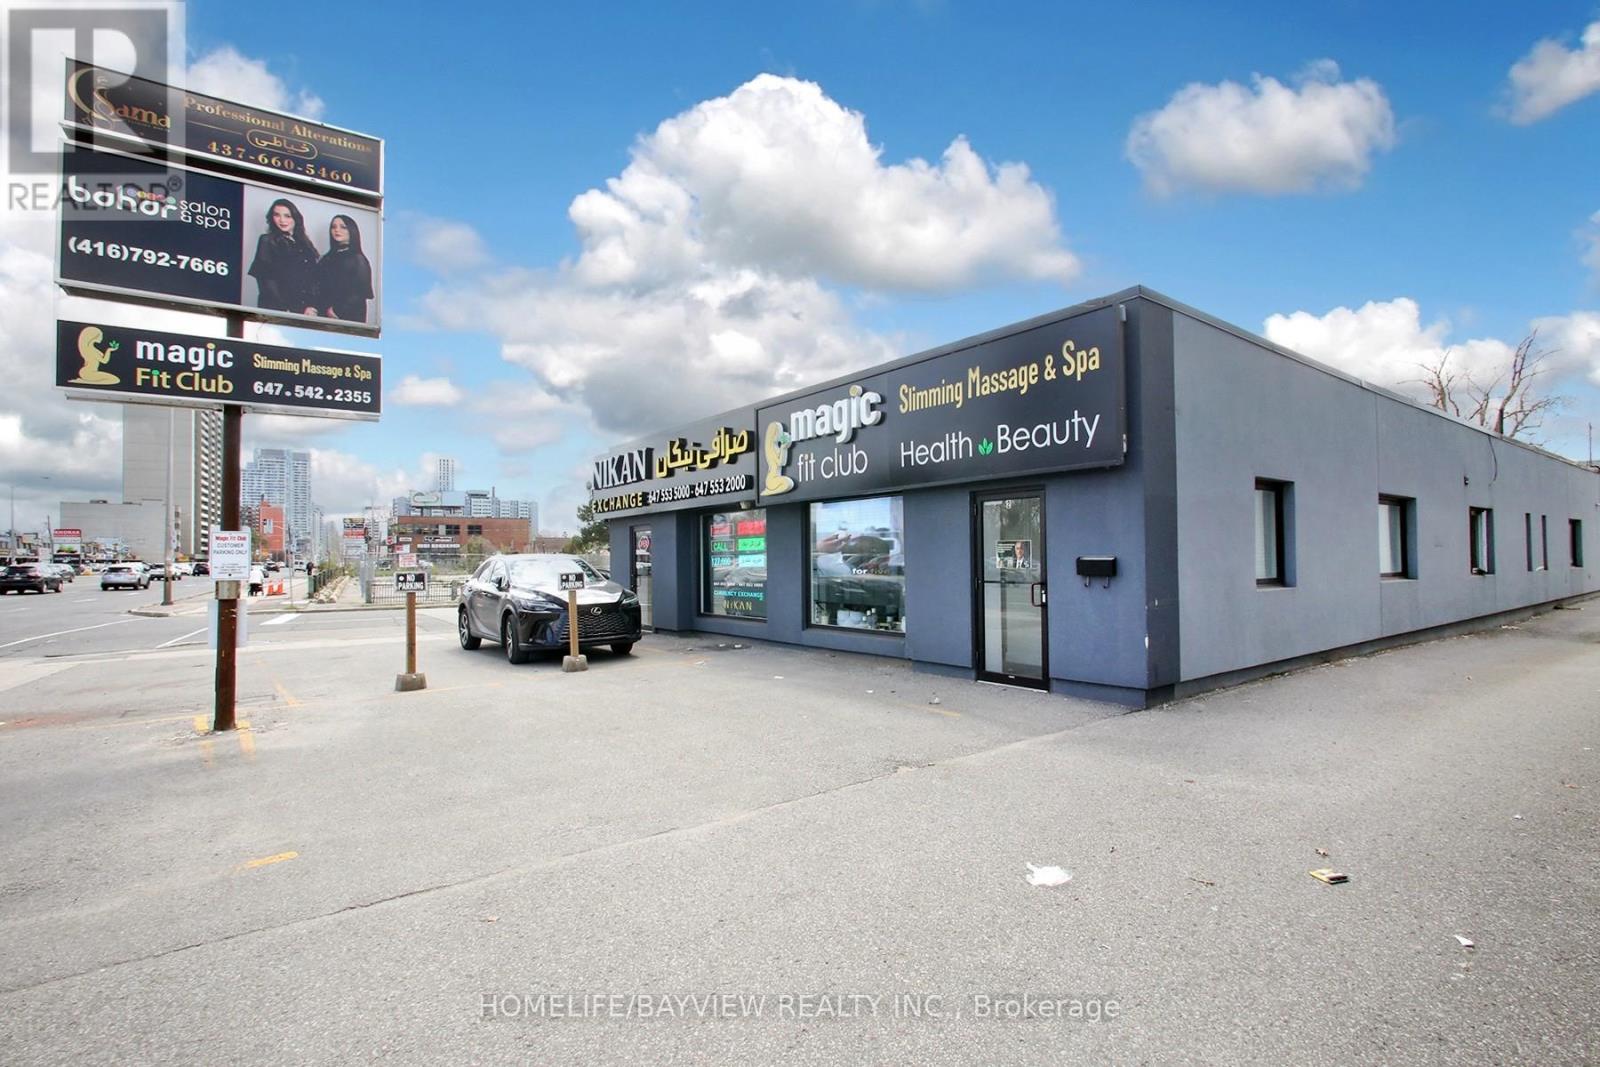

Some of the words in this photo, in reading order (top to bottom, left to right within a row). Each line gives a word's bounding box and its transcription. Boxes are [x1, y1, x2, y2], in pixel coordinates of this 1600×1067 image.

[184, 96, 285, 130] Professional
[291, 124, 372, 153] Alterations
[208, 141, 352, 184] 437-660-5460
[68, 175, 177, 219] bahar
[179, 200, 230, 218] salon
[181, 211, 192, 223] &
[195, 214, 230, 230] spa
[68, 236, 229, 277] (416)792-7666
[136, 339, 234, 371] magic
[253, 354, 300, 375] Slimming
[301, 360, 343, 379] Massage
[344, 365, 352, 377] &
[353, 364, 372, 381] Spa
[136, 367, 171, 390] Fit
[176, 372, 234, 394] Club
[900, 379, 963, 414] Slimming
[967, 361, 1038, 400] Massage
[1043, 354, 1057, 381] &
[1062, 339, 1100, 381] Spa
[253, 381, 371, 403] 647.542.2355
[790, 384, 883, 443] magic
[901, 431, 973, 467] Health
[997, 410, 1100, 454] Beauty
[591, 449, 647, 490] NIKAN
[797, 452, 815, 482] fit
[821, 447, 868, 478] club
[660, 488, 673, 501] 553
[674, 485, 690, 500] 5000
[695, 482, 708, 497] 647
[709, 478, 724, 494] 553
[725, 474, 746, 492] 2000
[592, 492, 643, 513] EXCHANGE
[398, 582, 424, 590] PARKING
[406, 574, 415, 582] NO
[561, 581, 583, 589] PARKING
